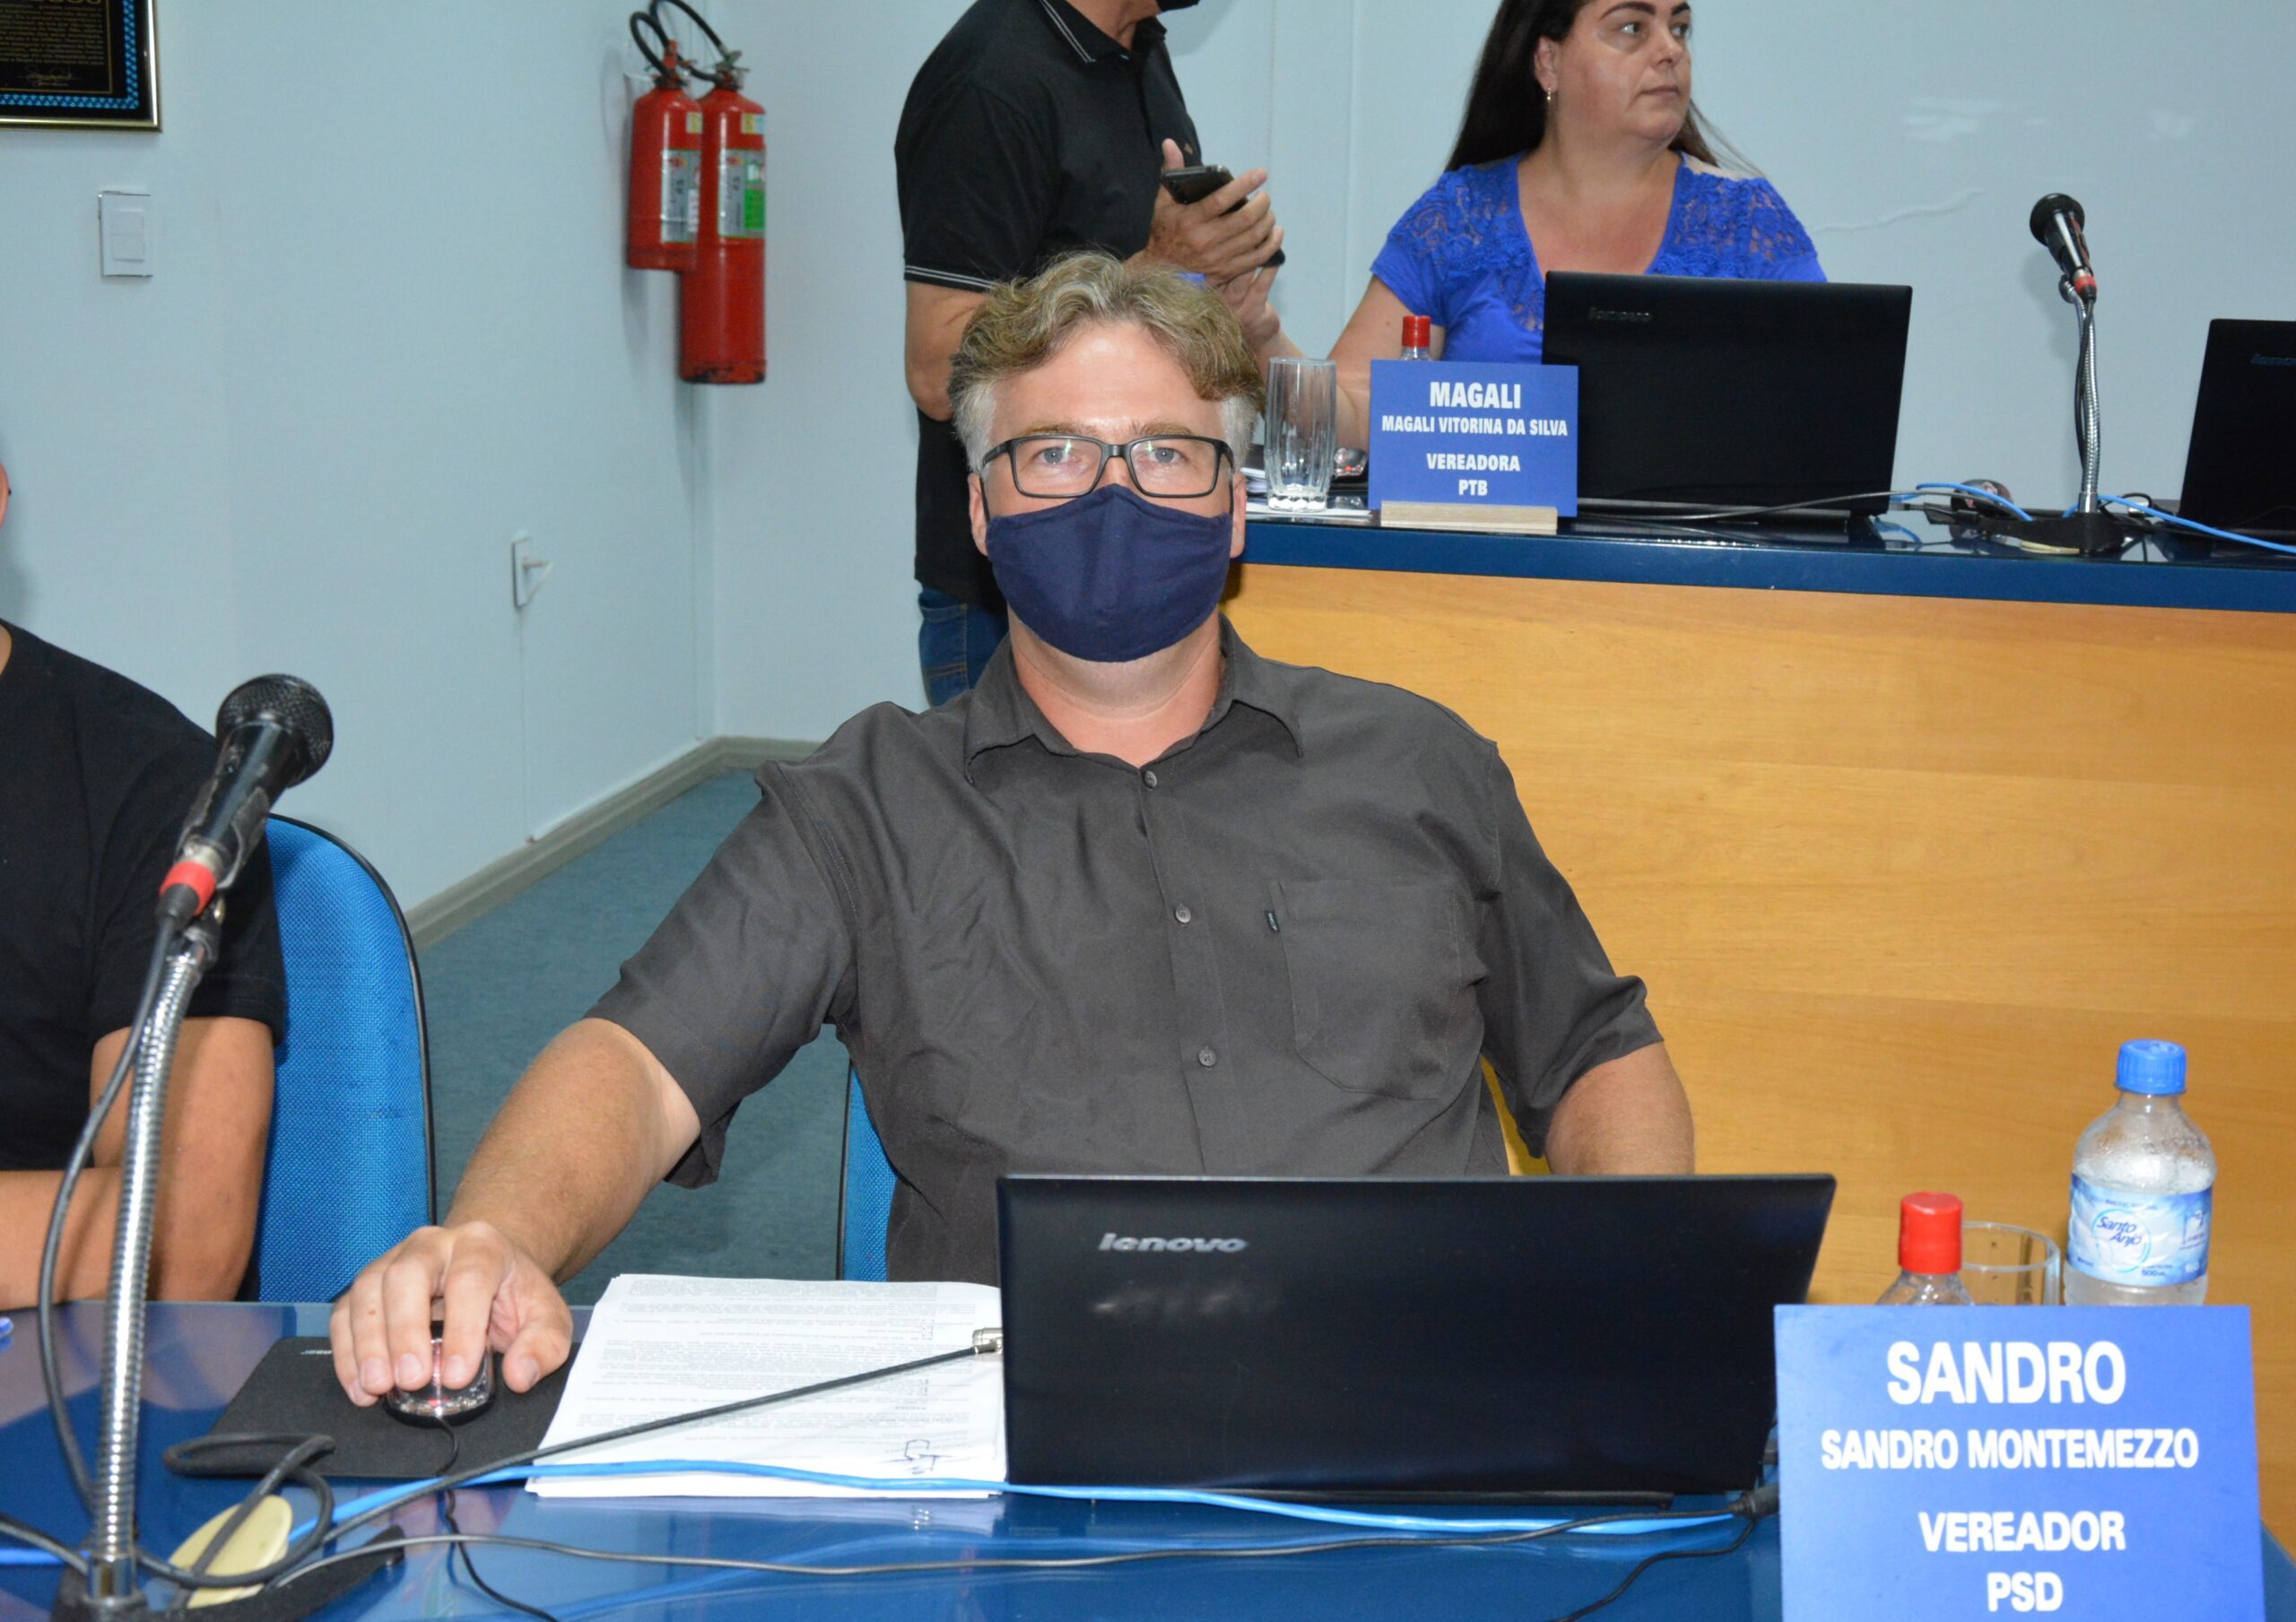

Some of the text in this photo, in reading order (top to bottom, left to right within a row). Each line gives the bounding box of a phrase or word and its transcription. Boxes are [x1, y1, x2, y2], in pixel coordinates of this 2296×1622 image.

[1430, 381, 1521, 409] MAGALI
[1382, 415, 1568, 436] MAGALI VITORINA DA SILVA
[1426, 453, 1521, 472] VEREADORA
[1458, 479, 1488, 496] PTB
[2097, 1216, 2137, 1233] Santo
[1098, 1232, 1248, 1253] lenovo
[2110, 1232, 2143, 1247] Anjo
[1887, 1340, 2126, 1405] SANDRO
[1821, 1428, 2199, 1470] SANDRO MONTEMEZZO
[1918, 1511, 2126, 1552] VEREADOR
[1987, 1572, 2063, 1612] PSD
